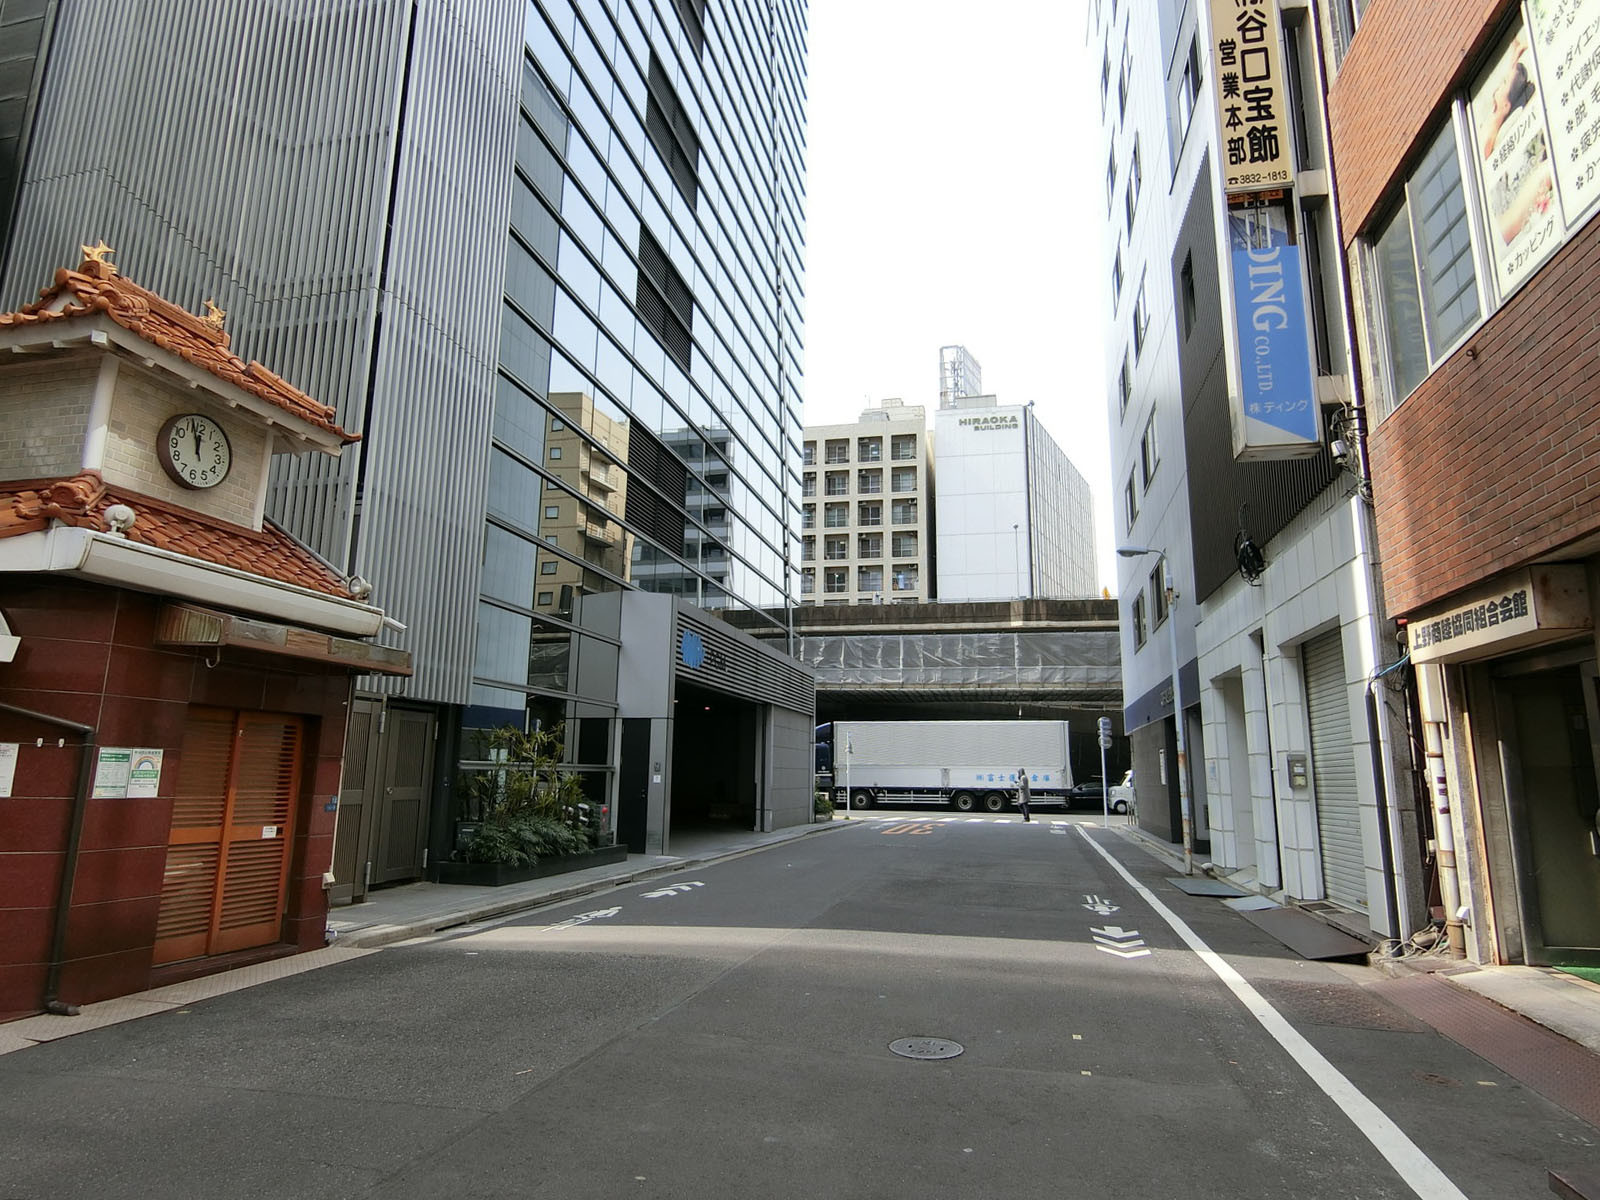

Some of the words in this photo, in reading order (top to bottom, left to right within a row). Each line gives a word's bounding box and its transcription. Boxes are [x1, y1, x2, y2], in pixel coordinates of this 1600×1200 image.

[1234, 0, 1280, 164] 谷口宝飾
[1219, 38, 1248, 166] 営業本部
[1239, 170, 1288, 185] 3832-1813
[1514, 215, 1555, 270] カッピング
[959, 415, 1018, 426] HIRAOKA
[974, 423, 1019, 431] BUILDING
[171, 437, 178, 448] 9
[213, 442, 220, 452] 2
[173, 450, 180, 461] 8
[214, 454, 221, 465] 3
[180, 462, 188, 472] 7
[209, 465, 217, 475] 4
[189, 469, 197, 480] 6
[200, 470, 208, 481] 5
